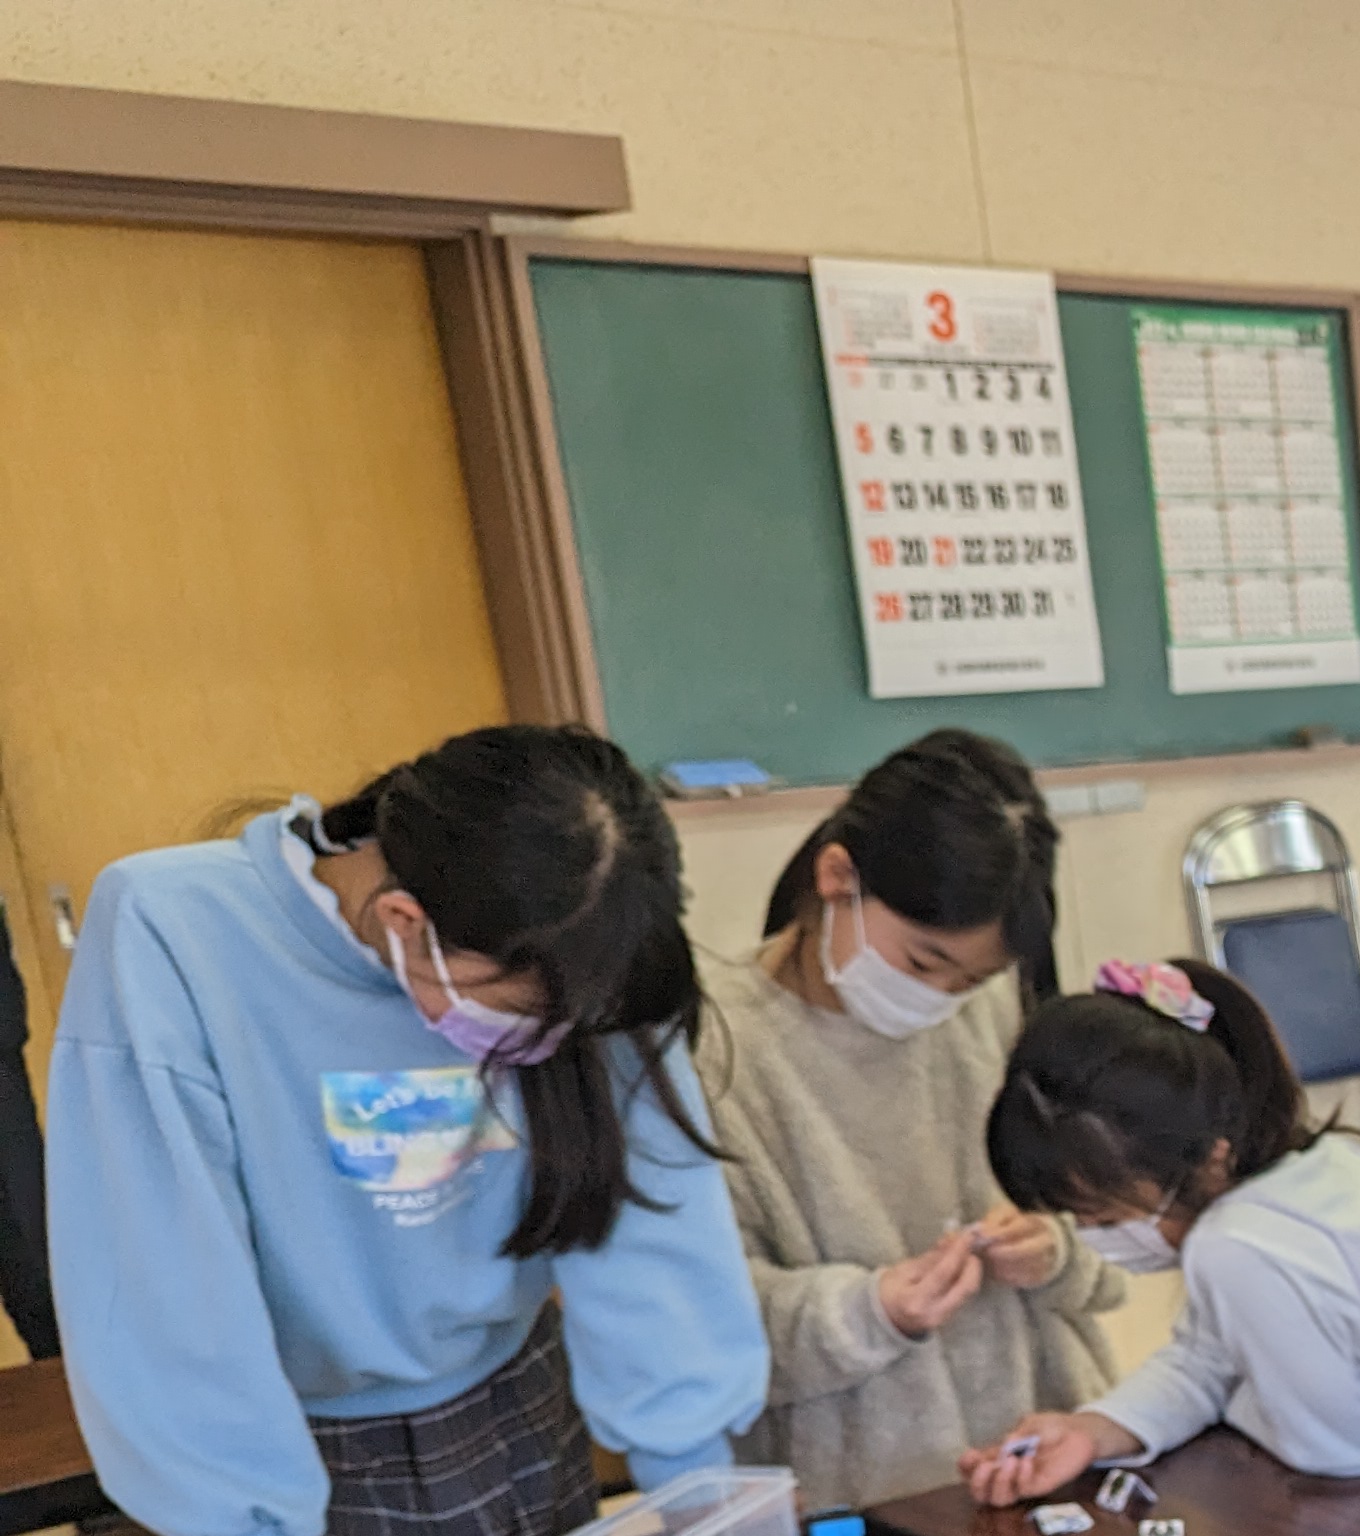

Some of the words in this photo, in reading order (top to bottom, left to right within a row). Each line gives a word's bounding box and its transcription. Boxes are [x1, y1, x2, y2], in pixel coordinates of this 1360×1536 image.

[925, 290, 957, 342] 3
[944, 371, 957, 400] 1
[974, 371, 990, 401] 2
[1005, 371, 1022, 401] 3
[1036, 373, 1053, 401] 4
[854, 422, 874, 454] 5
[887, 423, 906, 455] 6
[917, 425, 935, 456] 7
[950, 425, 969, 456] 8
[980, 424, 998, 456] 9
[1007, 423, 1034, 456] 10
[1040, 426, 1063, 456] 11
[860, 480, 886, 512] 12
[891, 481, 919, 512] 13
[921, 481, 950, 512] 14
[953, 481, 981, 512] 15
[983, 481, 1011, 511] 16
[1014, 481, 1037, 511] 17
[1044, 481, 1070, 512] 18
[867, 536, 894, 567] 19
[899, 536, 928, 567] 20
[931, 535, 957, 567] 21
[960, 536, 988, 567] 22
[992, 536, 1019, 566] 23
[1022, 536, 1048, 566] 24
[1051, 536, 1078, 565] 25
[876, 592, 903, 622] 26
[908, 591, 934, 622] 27
[939, 591, 966, 621] 28
[969, 591, 997, 620] 29
[1000, 590, 1027, 619] 30
[1031, 590, 1056, 618] 31
